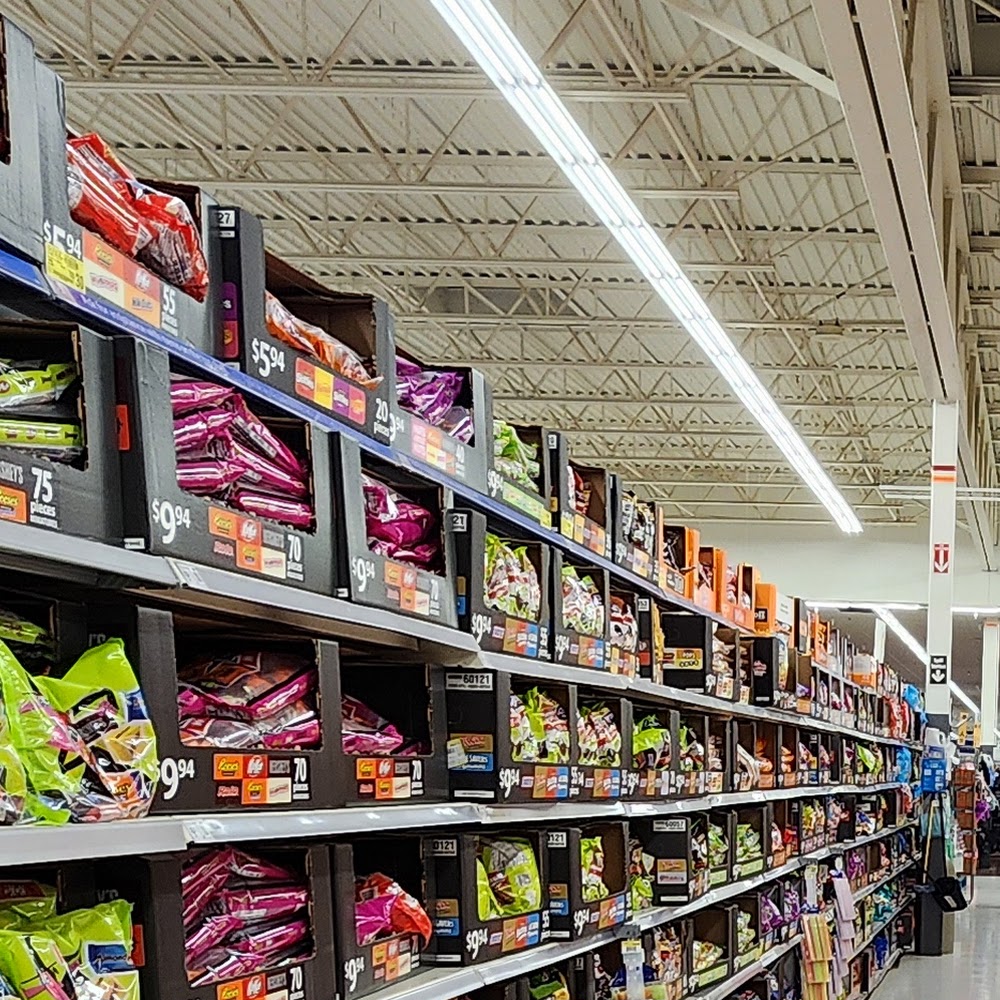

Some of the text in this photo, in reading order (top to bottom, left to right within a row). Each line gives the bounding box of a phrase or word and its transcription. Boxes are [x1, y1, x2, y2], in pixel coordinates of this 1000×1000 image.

[252, 338, 285, 377] $594
[31, 466, 53, 503] 75
[30, 501, 56, 517] pieces
[151, 499, 191, 544] $994
[287, 534, 301, 562] 70
[352, 557, 375, 592] $994
[471, 612, 492, 645] $994
[463, 675, 490, 684] 60121
[293, 757, 307, 782] 70
[499, 768, 520, 797] $994
[466, 928, 488, 959] $994
[290, 966, 302, 992] 70
[344, 956, 365, 992] $994
